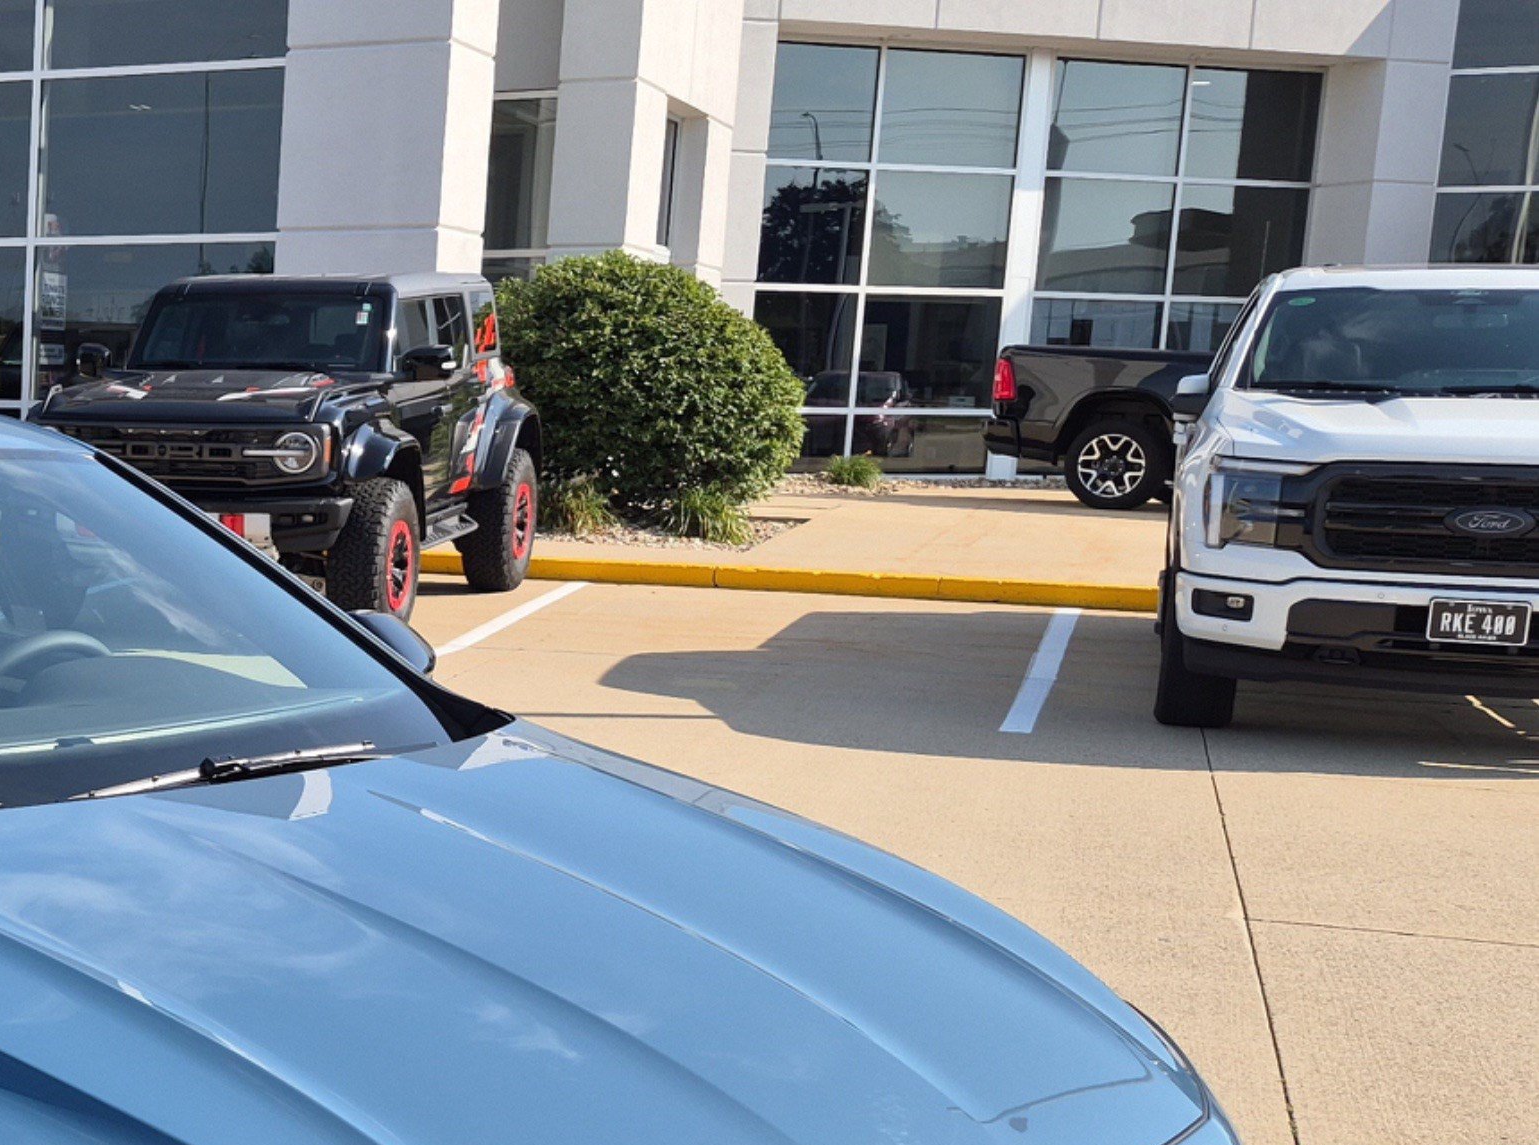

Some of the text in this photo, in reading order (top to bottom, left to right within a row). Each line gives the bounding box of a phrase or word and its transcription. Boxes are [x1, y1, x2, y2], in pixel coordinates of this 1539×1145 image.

[1468, 514, 1510, 528] Ford
[1440, 612, 1516, 635] RKE 400
